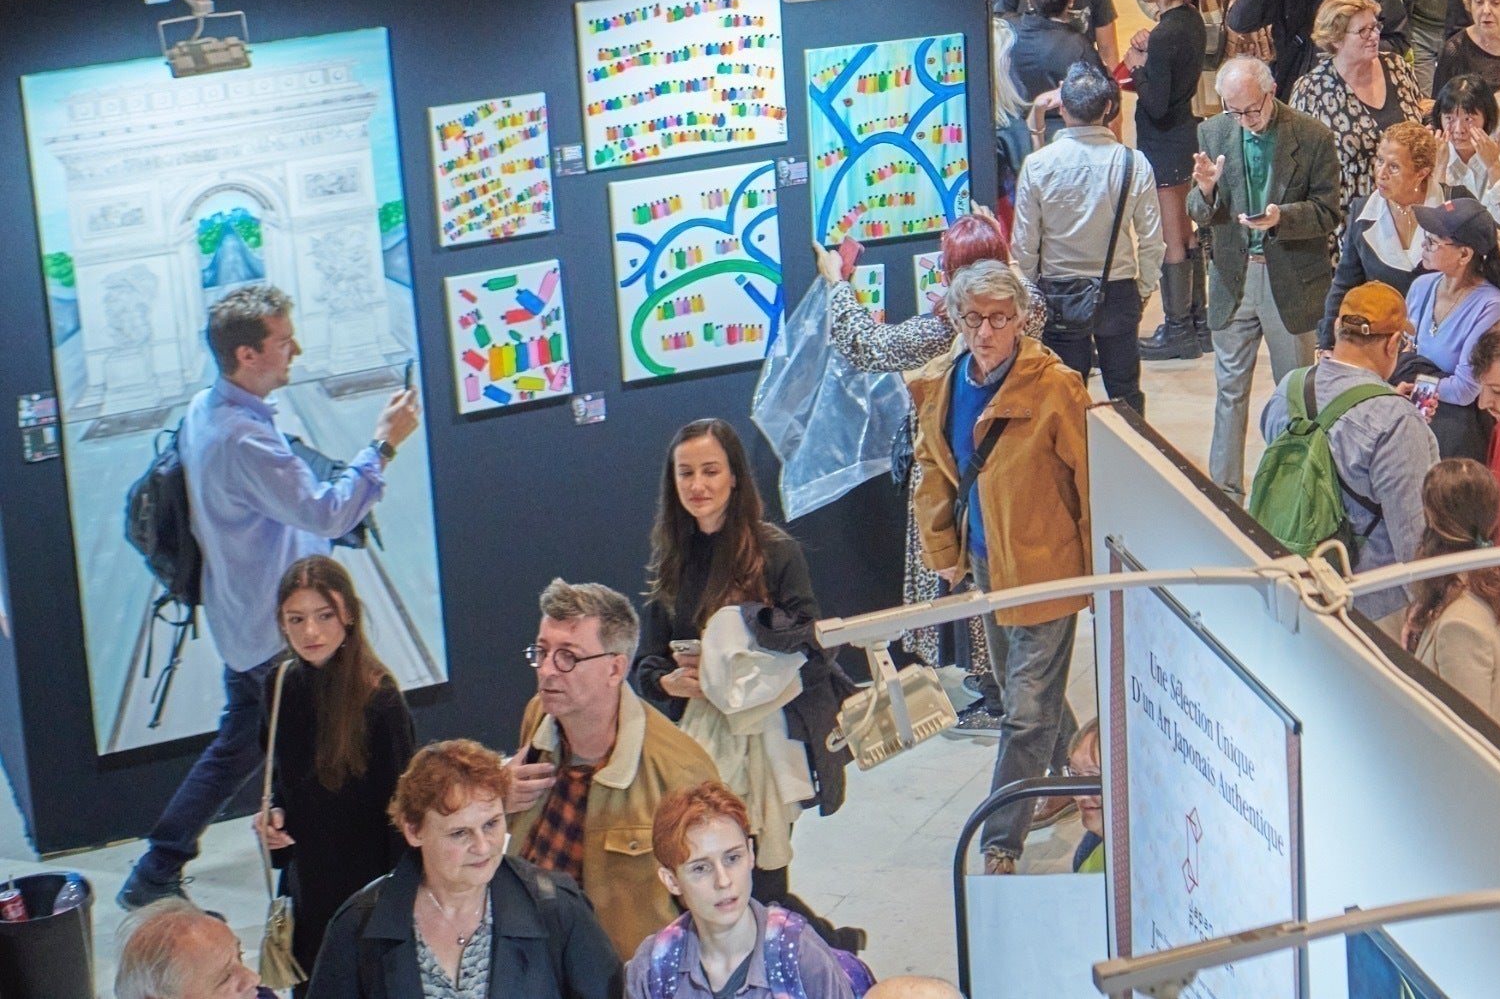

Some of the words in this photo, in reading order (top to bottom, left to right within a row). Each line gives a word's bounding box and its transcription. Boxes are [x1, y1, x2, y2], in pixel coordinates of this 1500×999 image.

[1150, 651, 1168, 692] Une
[1216, 720, 1256, 781] Unique
[1157, 703, 1172, 741] Art
[1173, 720, 1217, 787] Japonais
[1218, 770, 1285, 857] Authentique
